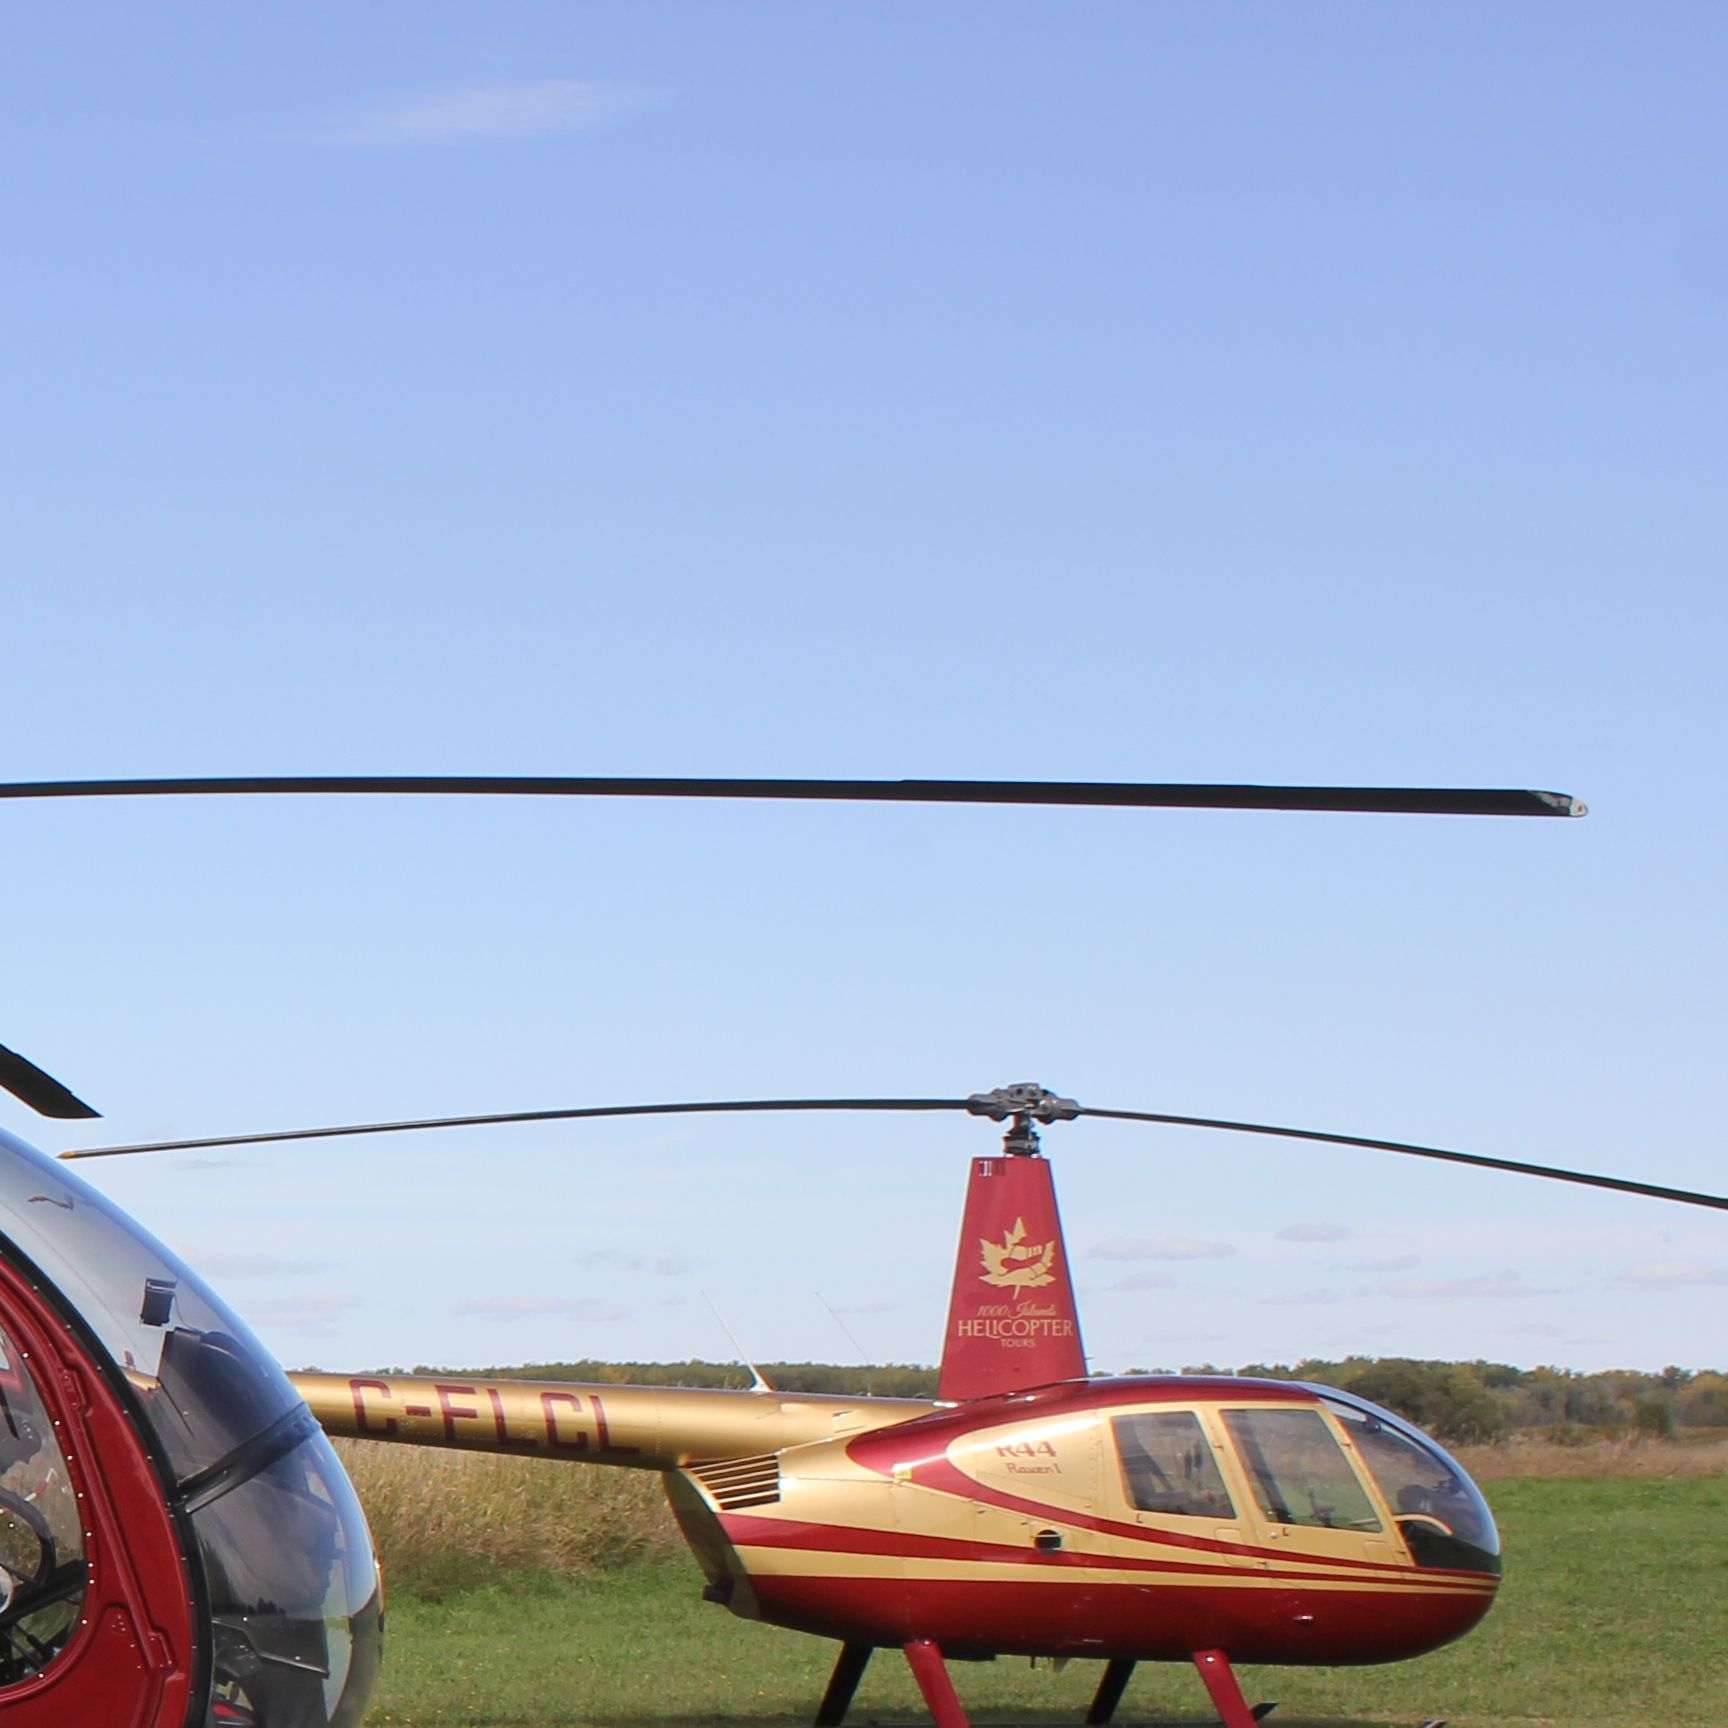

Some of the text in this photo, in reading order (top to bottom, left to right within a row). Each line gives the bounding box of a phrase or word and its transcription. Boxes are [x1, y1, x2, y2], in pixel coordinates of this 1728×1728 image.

[977, 1300, 1057, 1320] 1000 Islands
[958, 1320, 1073, 1339] HELICOPTER
[1001, 1339, 1036, 1348] TOURS
[349, 1379, 641, 1455] C-FLCL
[996, 1441, 1058, 1457] R44
[1005, 1462, 1053, 1474] Raven
